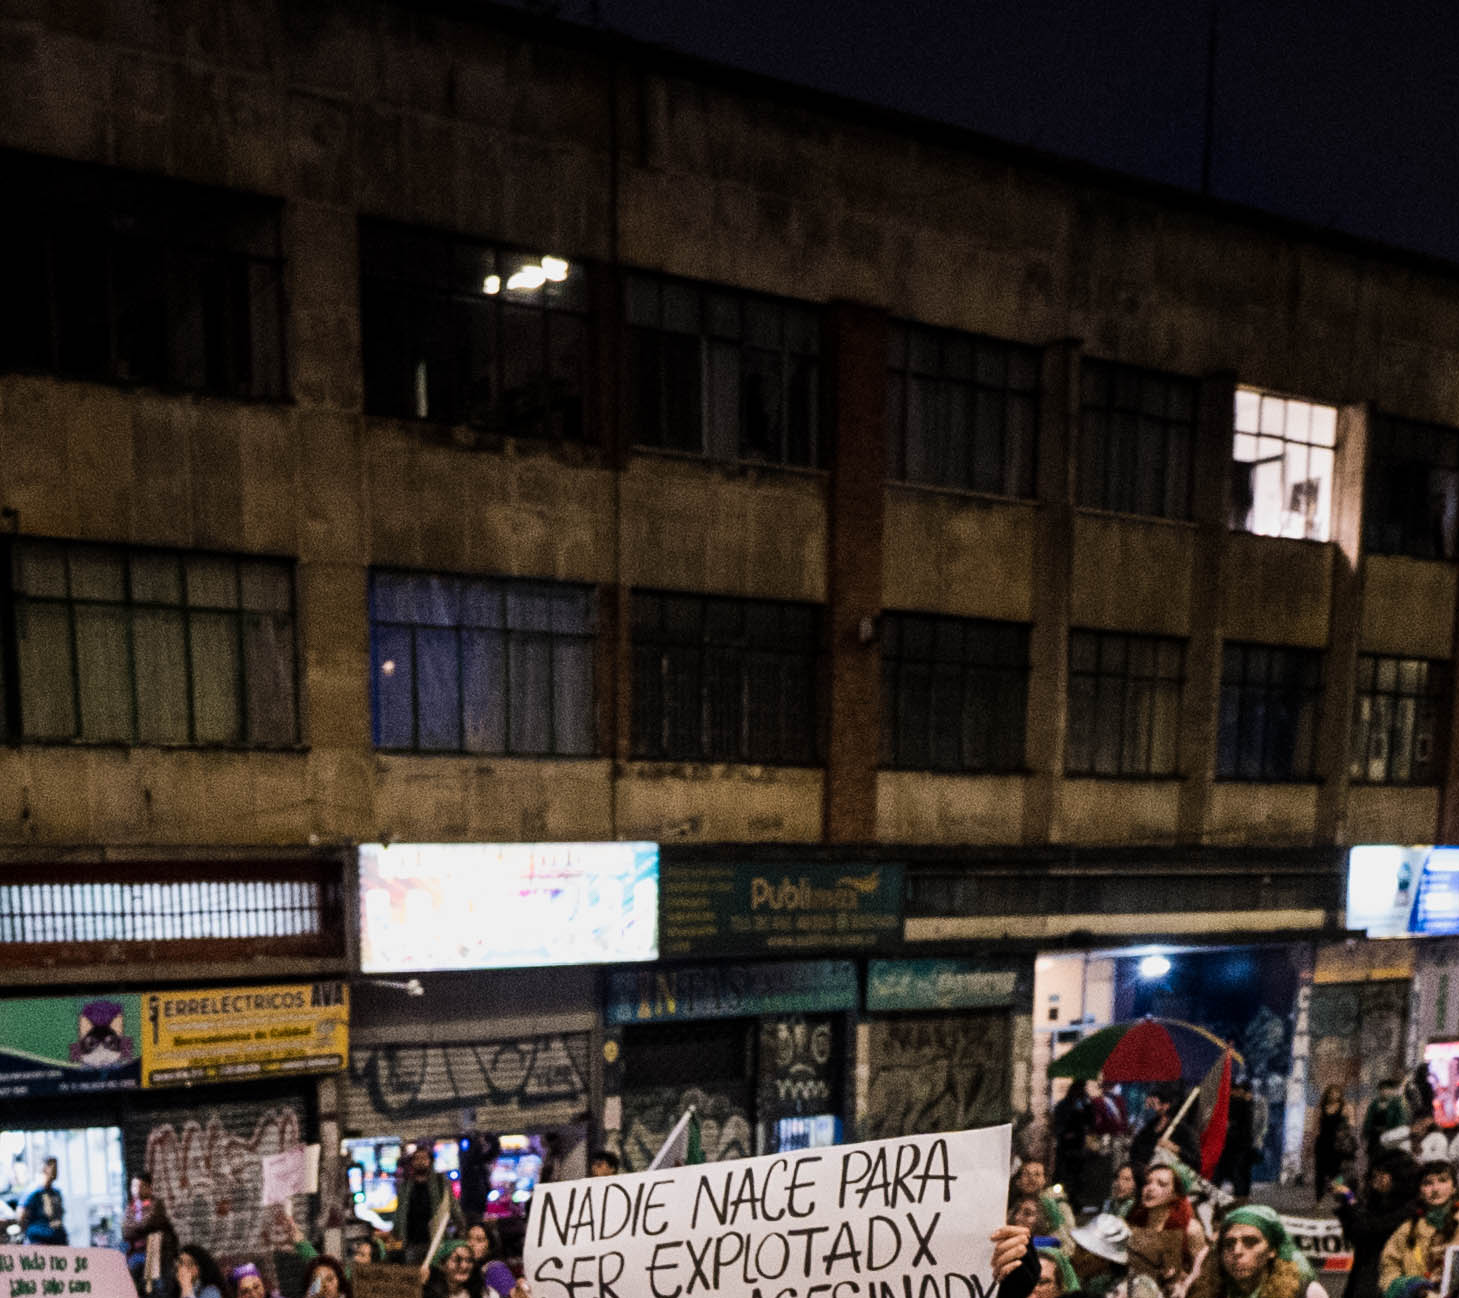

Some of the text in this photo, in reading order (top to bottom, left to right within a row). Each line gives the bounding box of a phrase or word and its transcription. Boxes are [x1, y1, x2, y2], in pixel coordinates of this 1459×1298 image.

[537, 1138, 958, 1248] NADIE NACE PARA
